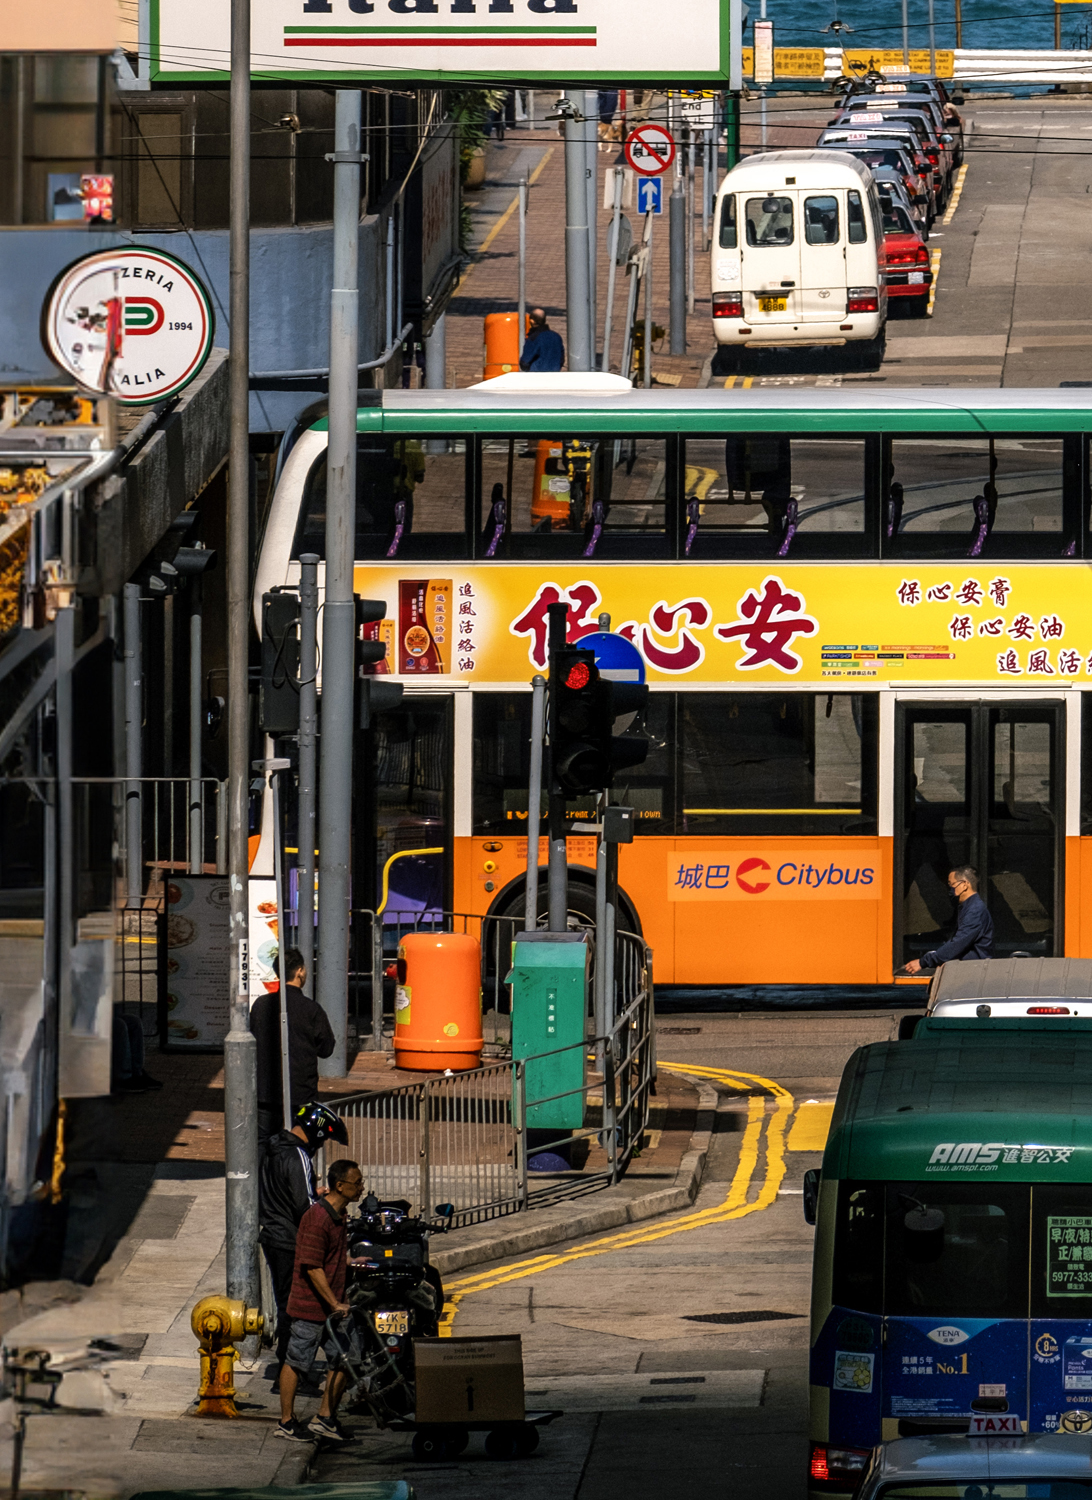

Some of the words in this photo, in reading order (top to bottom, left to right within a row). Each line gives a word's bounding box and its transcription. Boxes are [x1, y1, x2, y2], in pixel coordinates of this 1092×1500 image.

[168, 322, 193, 331] 1994
[898, 579, 1011, 607] 保心安膏
[457, 582, 477, 671] 追風活絡油
[949, 615, 1064, 640] 保心安油
[675, 863, 730, 890] 城巴
[776, 862, 875, 891] Citybus
[928, 1143, 1005, 1164] AMS
[925, 1164, 999, 1173] www.amspt.com
[378, 1323, 407, 1333] 5718
[1043, 1340, 1050, 1352] 8
[936, 1352, 970, 1375] No.1
[973, 1418, 1017, 1432] TAXI
